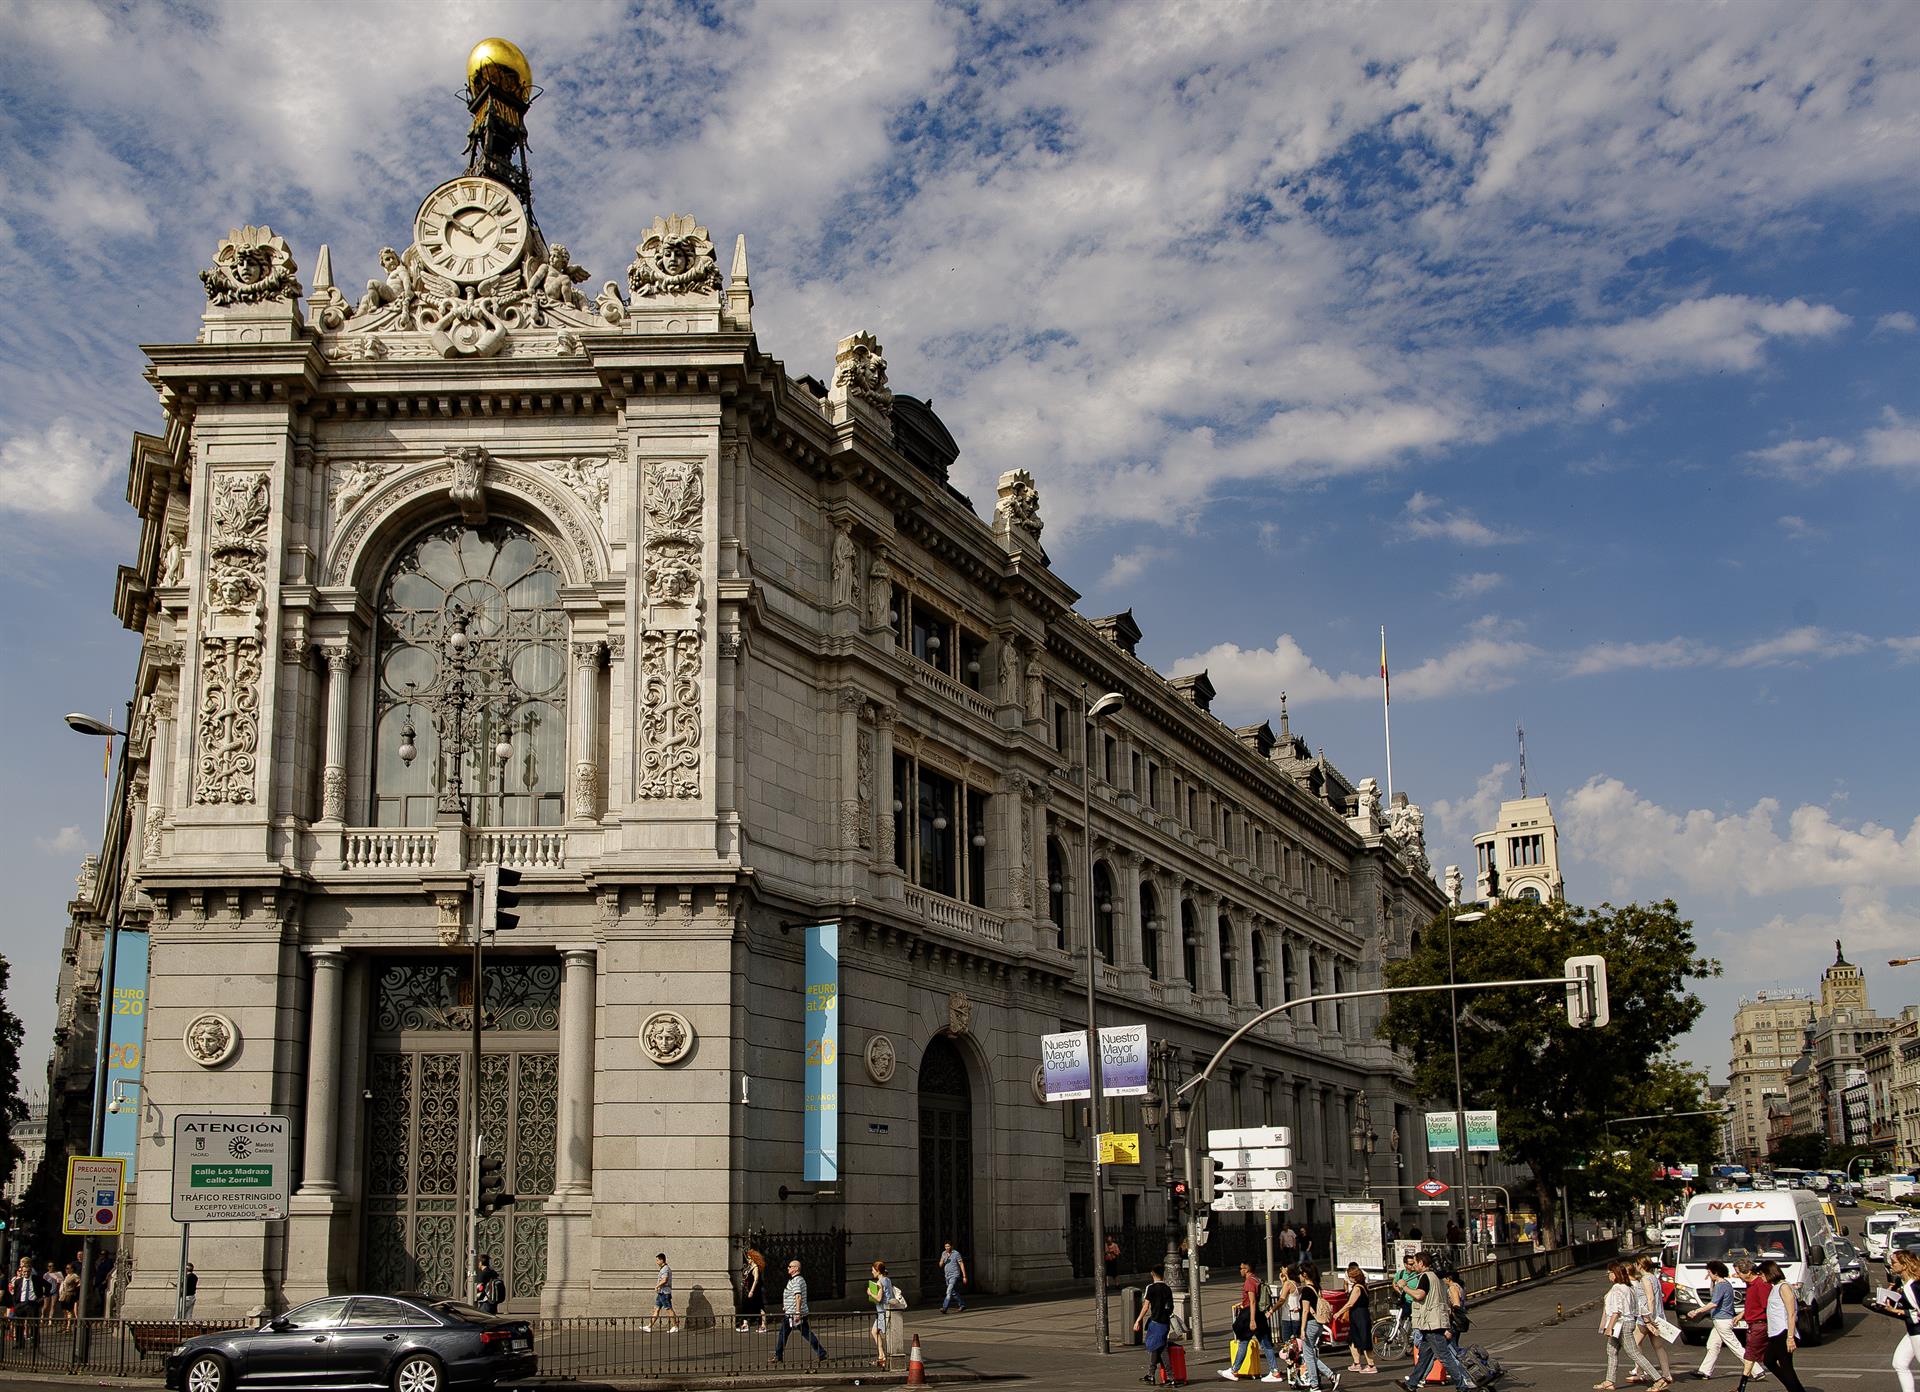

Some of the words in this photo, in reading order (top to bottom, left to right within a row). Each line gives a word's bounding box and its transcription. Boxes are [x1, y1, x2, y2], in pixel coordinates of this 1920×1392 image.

[113, 988, 144, 999] EURO
[808, 984, 836, 994] #EURO
[807, 1000, 817, 1011] at
[818, 995, 835, 1010] 20
[1102, 1033, 1139, 1044] Nuestro
[1044, 1039, 1081, 1050] Nuestro
[1103, 1044, 1133, 1055] Mayor
[807, 1040, 835, 1065] 20
[1046, 1050, 1074, 1060] Mayor
[1047, 1059, 1080, 1071] Orgullo
[1104, 1054, 1138, 1066] Orgullo
[184, 1122, 282, 1133] ATENCIÓN
[180, 1193, 220, 1201] TRÁFICO
[1708, 1202, 1766, 1210] NACEX
